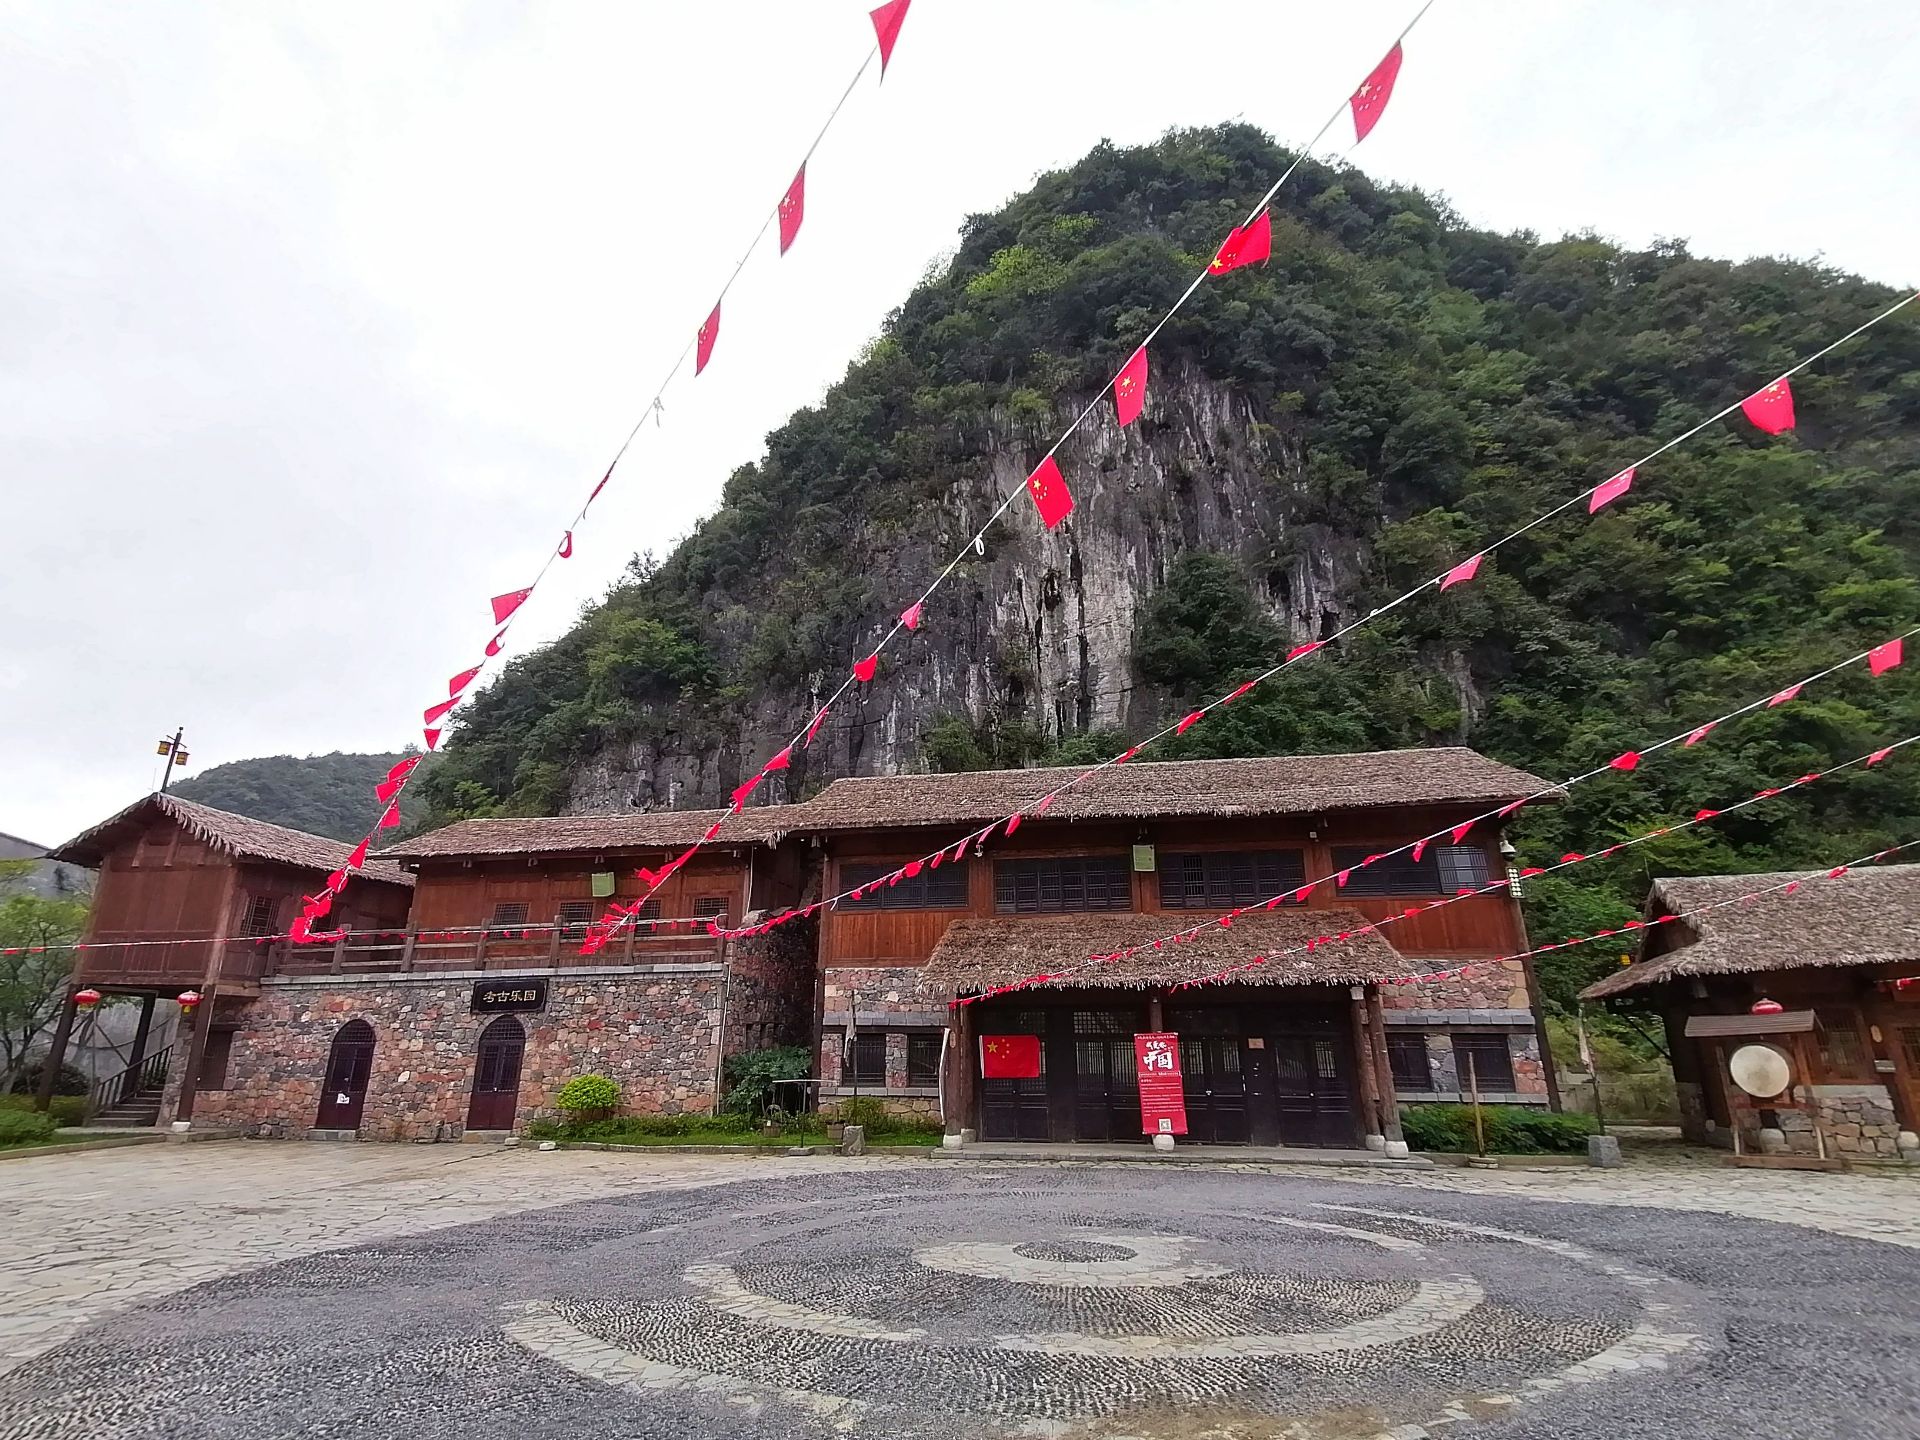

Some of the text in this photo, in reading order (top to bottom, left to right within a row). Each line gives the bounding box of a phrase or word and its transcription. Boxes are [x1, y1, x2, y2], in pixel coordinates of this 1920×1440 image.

[482, 990, 536, 1003] 考古乐园
[1143, 1050, 1173, 1071] 中国
